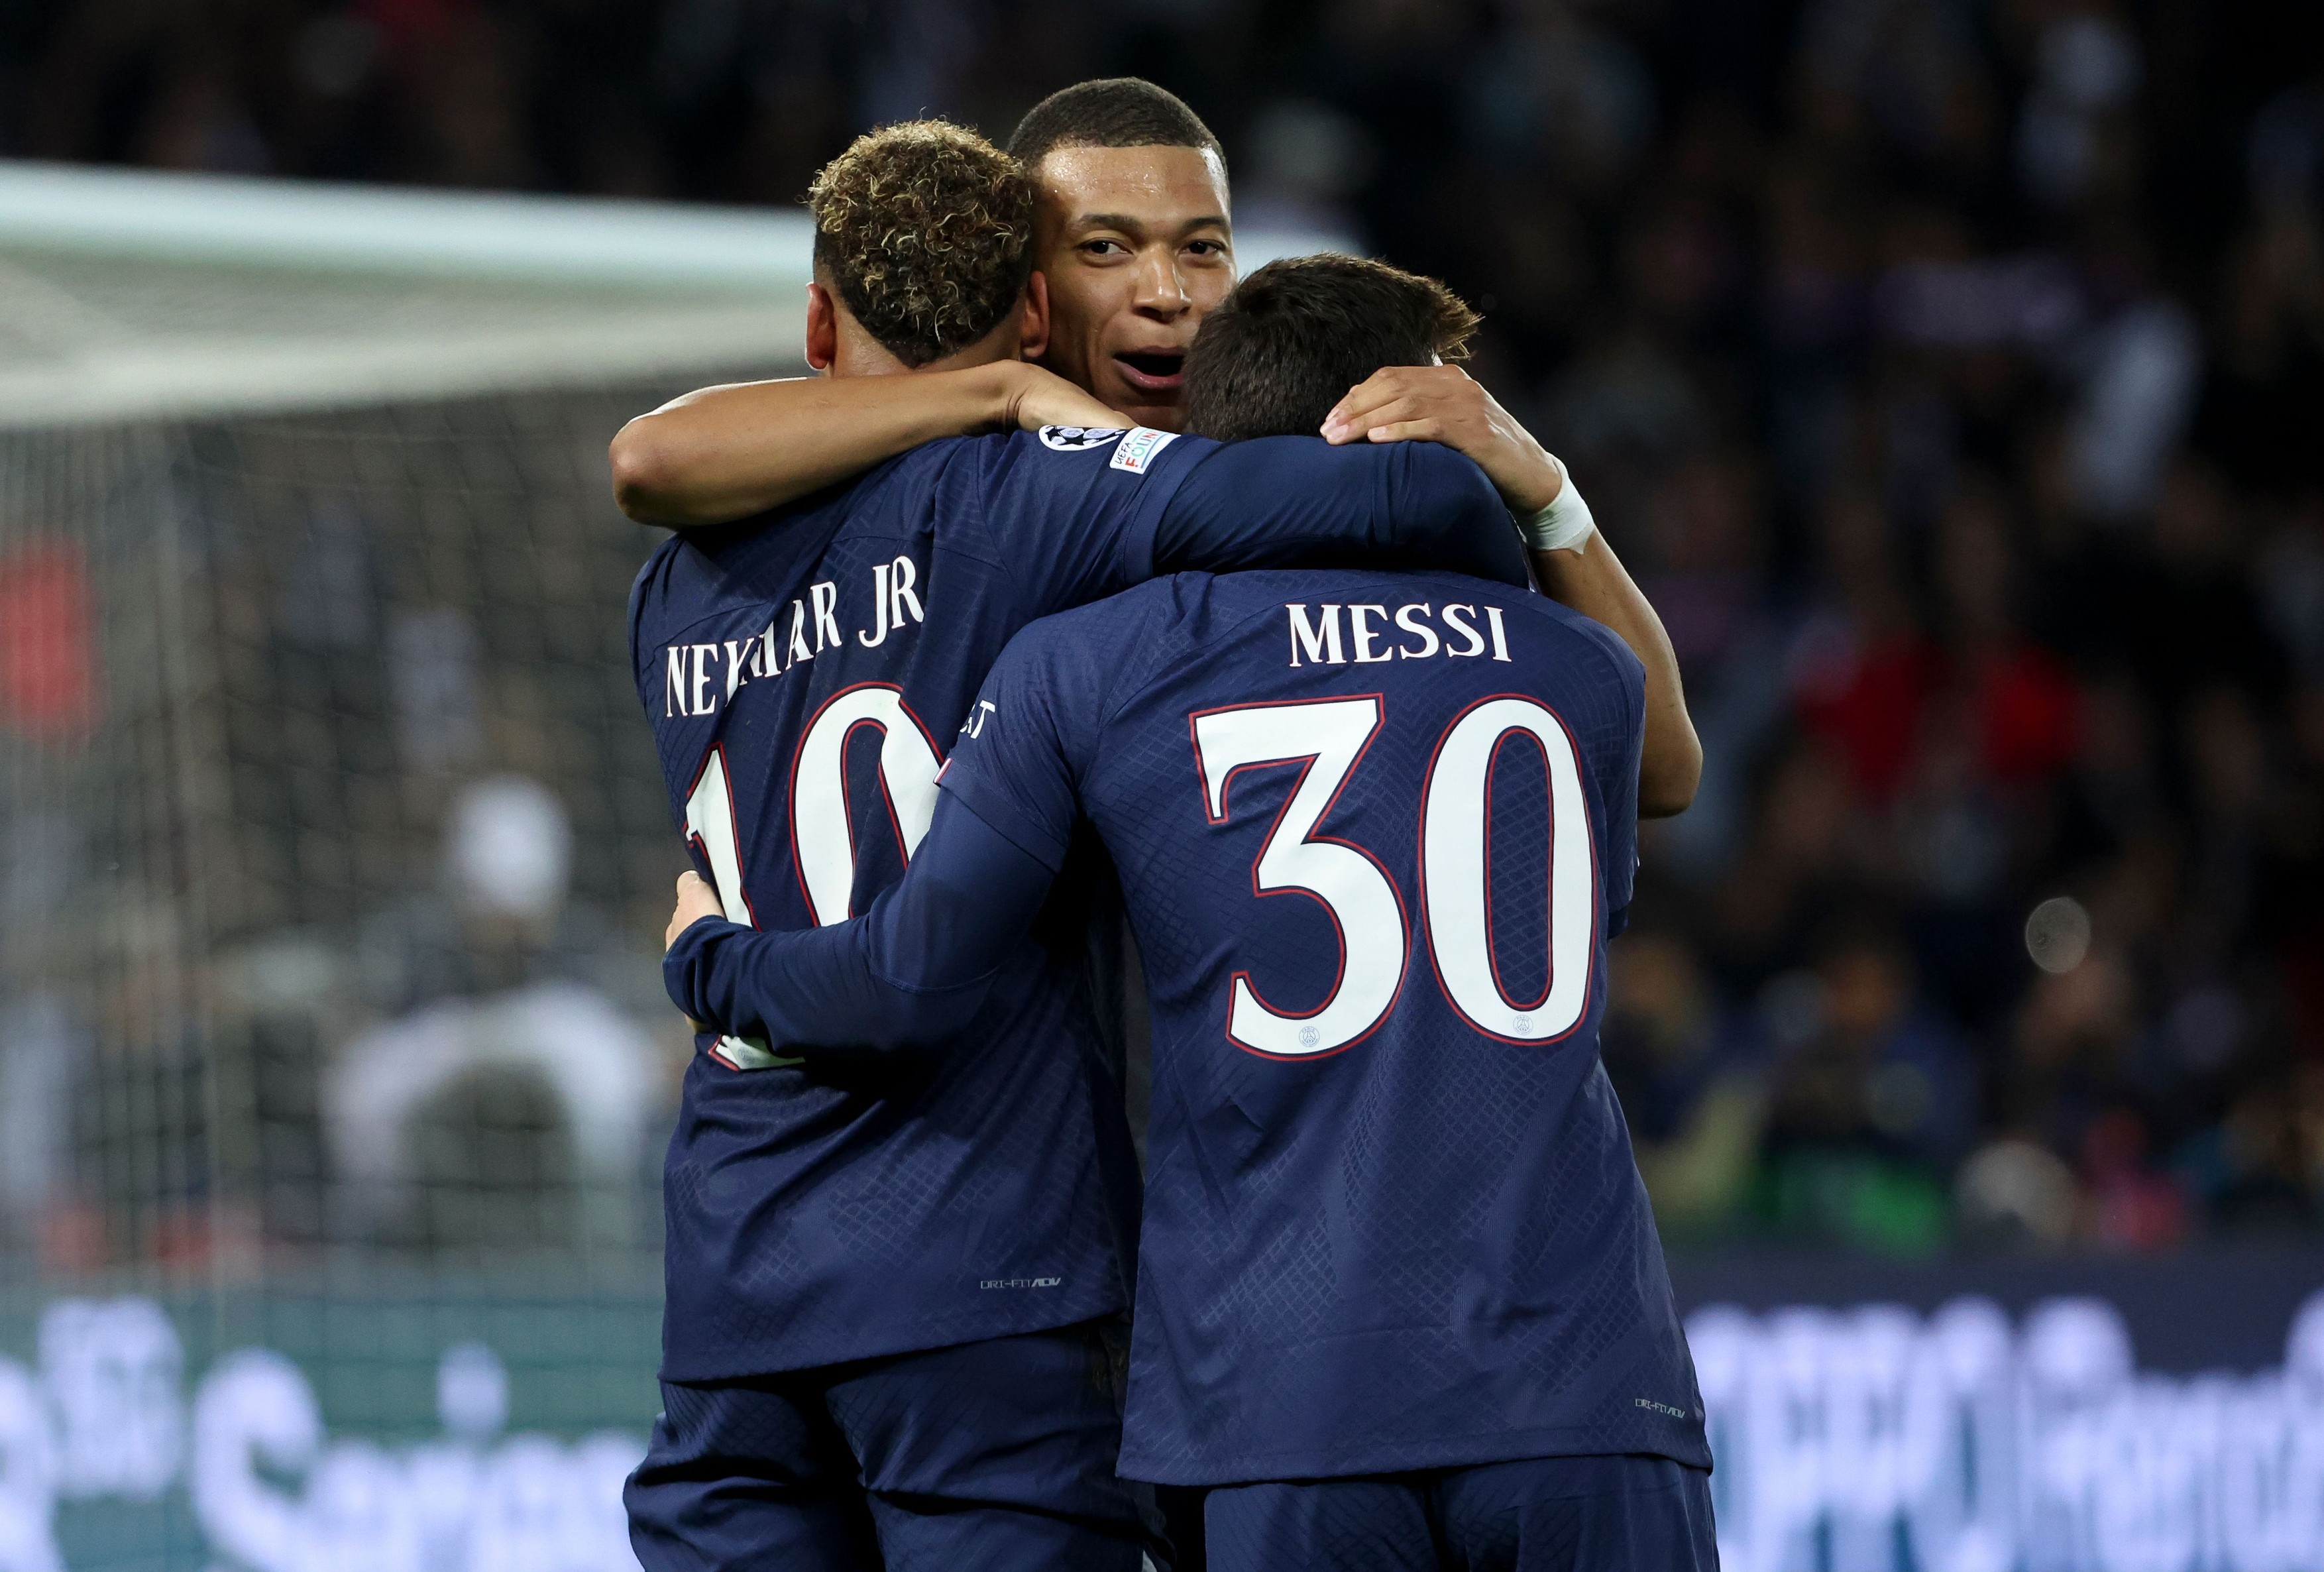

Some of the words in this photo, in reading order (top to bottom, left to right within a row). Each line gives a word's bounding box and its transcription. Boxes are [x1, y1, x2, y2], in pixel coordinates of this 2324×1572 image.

[1115, 442, 1132, 465] UEFA
[1125, 430, 1160, 468] FOUN
[859, 555, 924, 647] JR
[1285, 602, 1513, 667] MESSI
[1189, 693, 1598, 1061] 30
